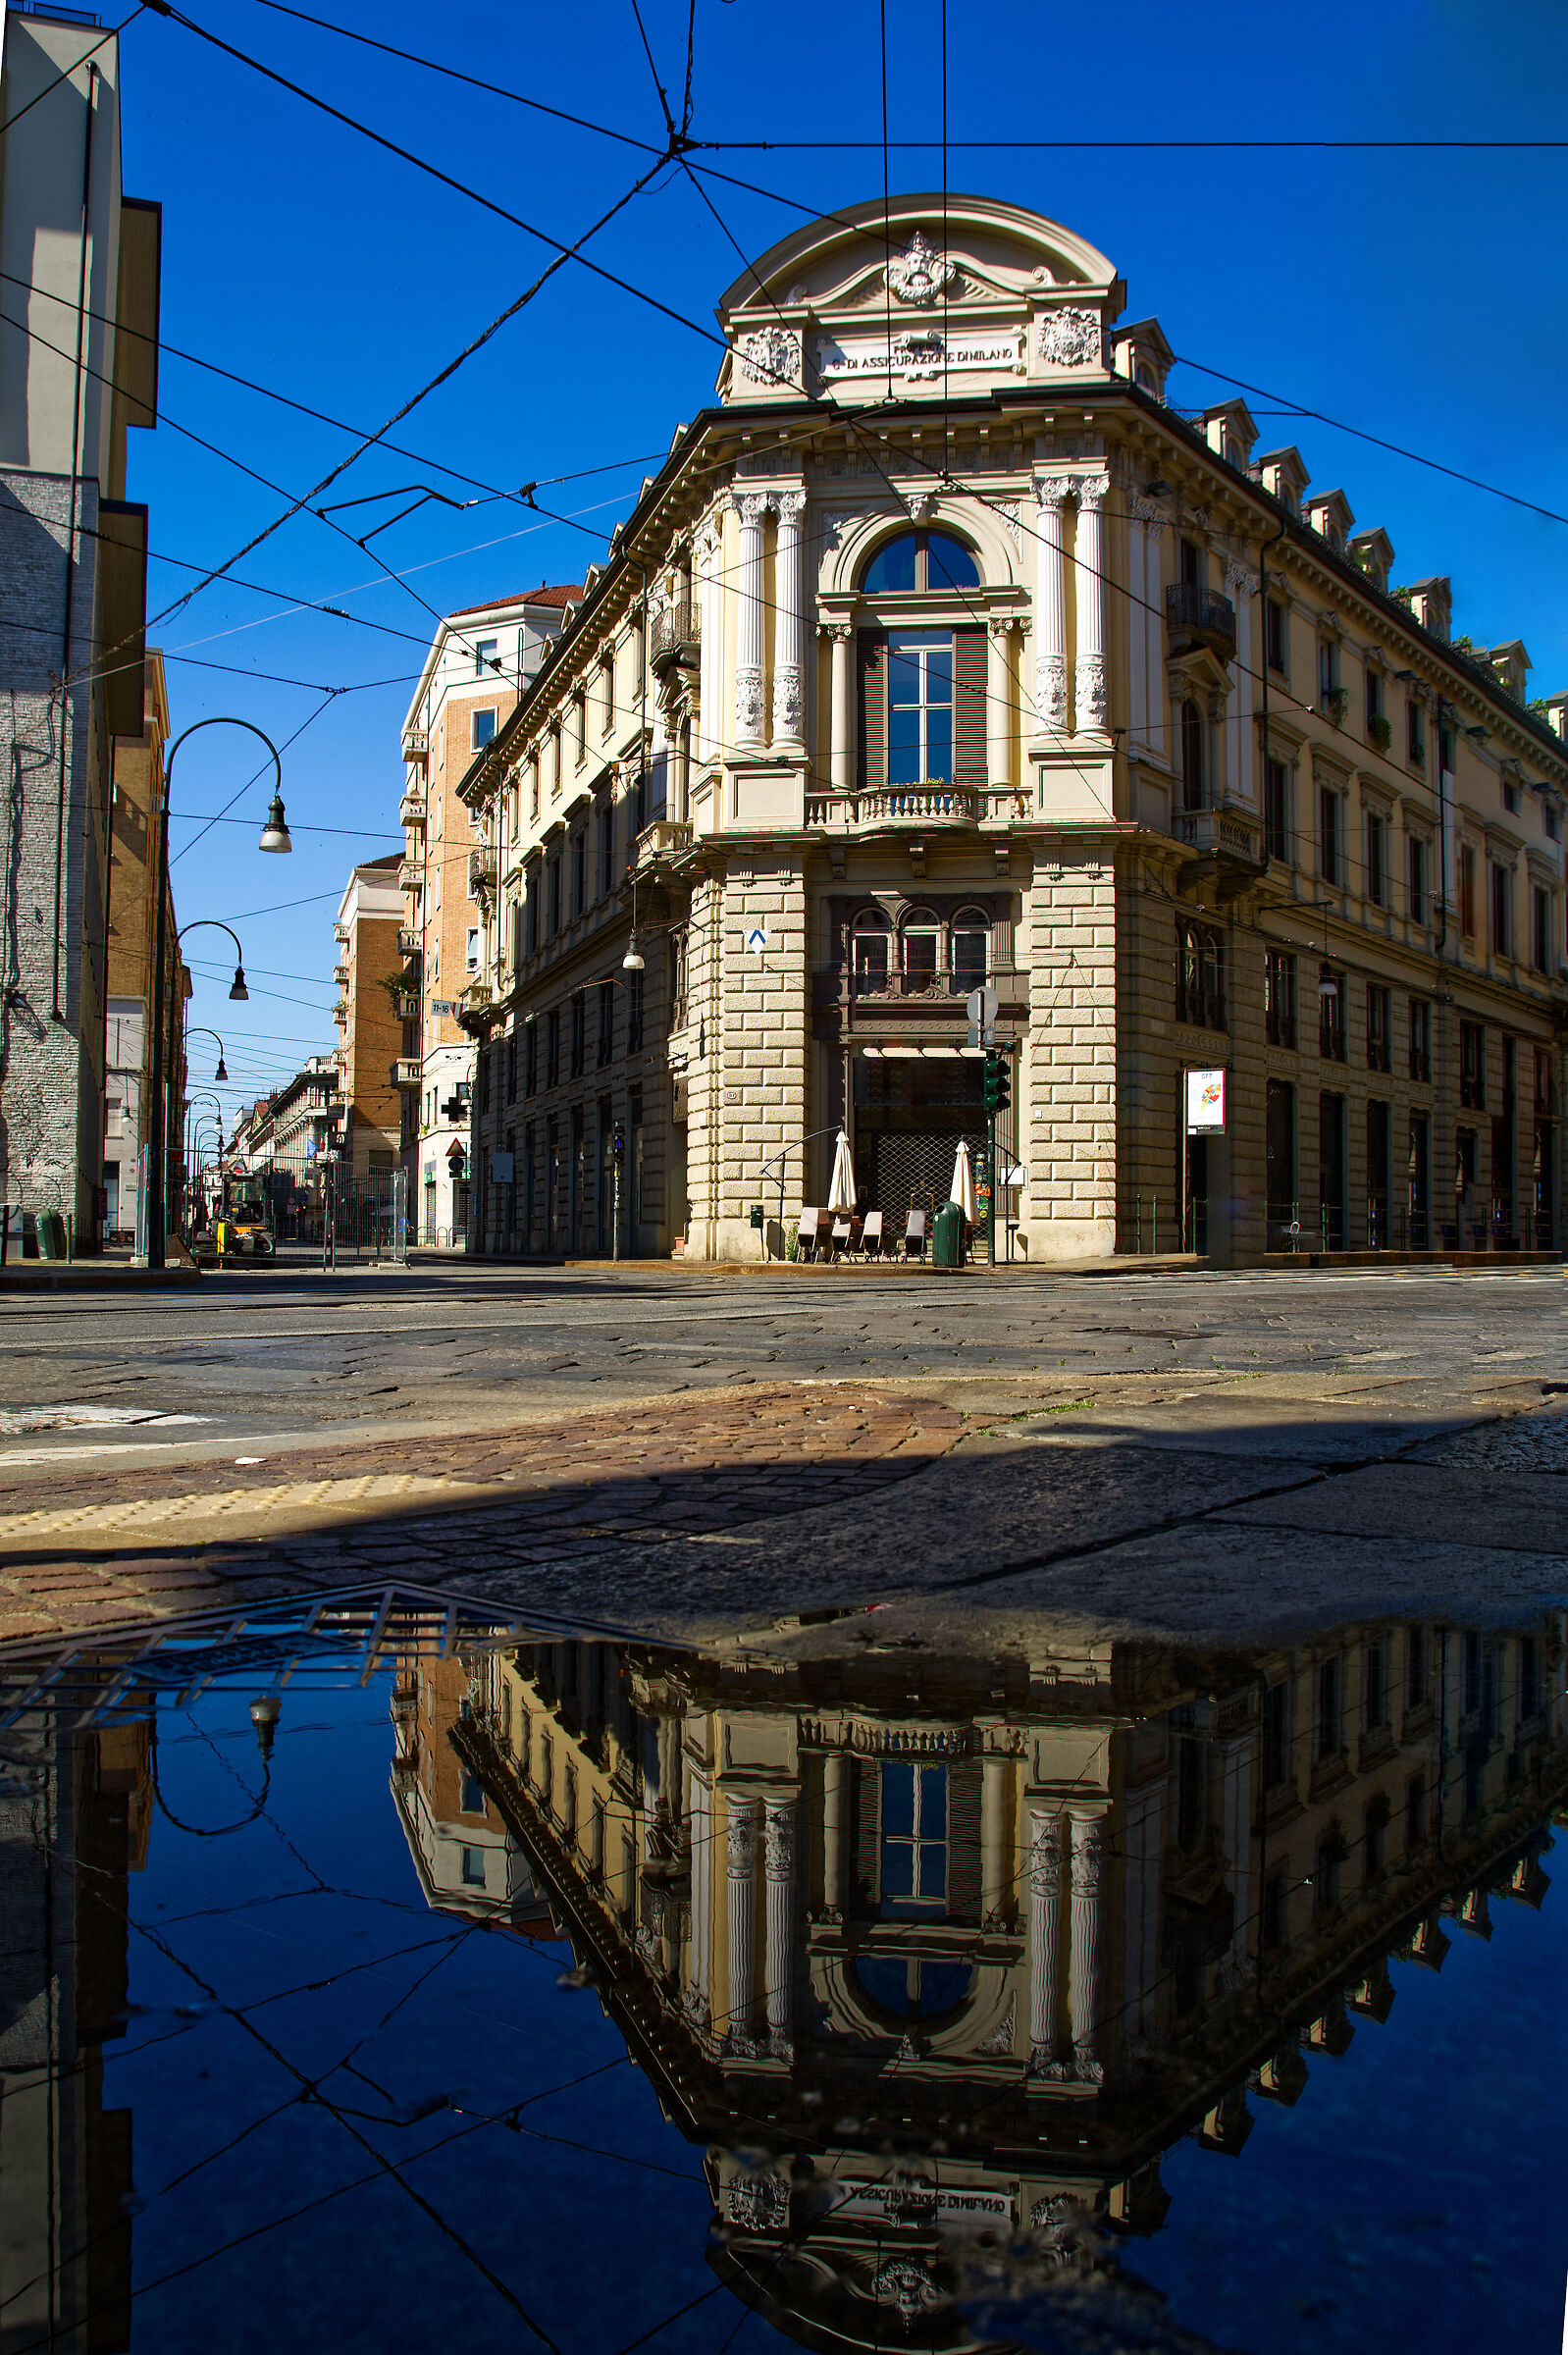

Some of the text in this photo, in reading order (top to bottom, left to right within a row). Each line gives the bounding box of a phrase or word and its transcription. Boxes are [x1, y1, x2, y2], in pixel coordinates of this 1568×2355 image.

[847, 358, 858, 369] DI
[862, 352, 955, 368] ASSICURAZIONE
[957, 351, 968, 362] DI
[968, 348, 1013, 361] MILANO
